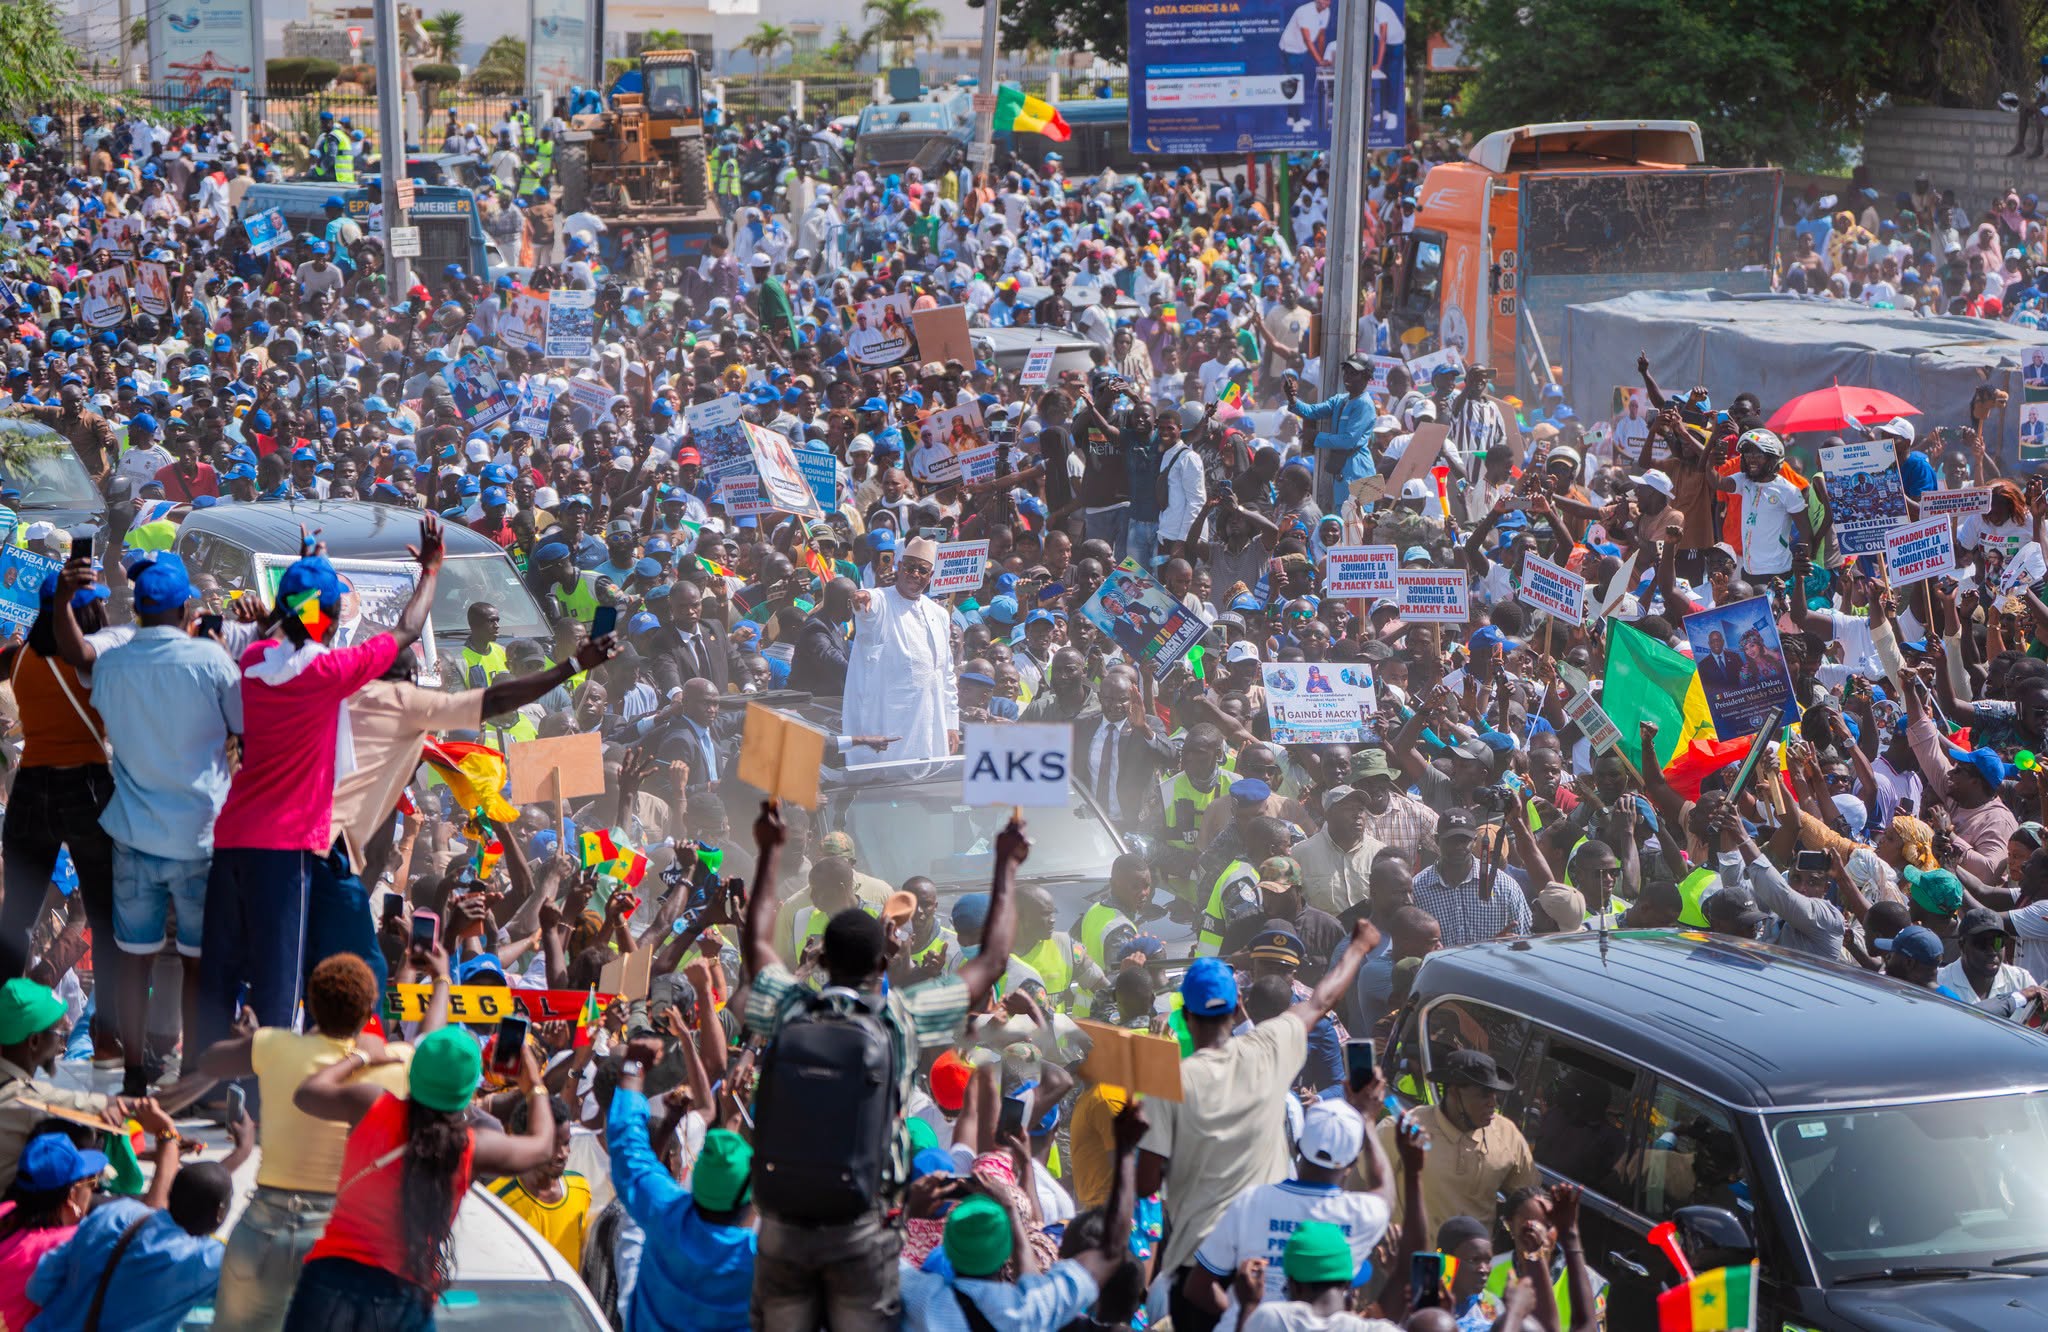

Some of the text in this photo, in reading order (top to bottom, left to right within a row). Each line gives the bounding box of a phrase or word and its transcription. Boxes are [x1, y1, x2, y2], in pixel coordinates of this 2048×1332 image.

[1153, 3, 1240, 15] DATA SCIENCE & IA
[1503, 251, 1514, 269] 90
[1503, 273, 1514, 290] 80
[1501, 297, 1515, 314] 60
[961, 452, 991, 465] MAMADOU
[1923, 493, 1962, 502] MAMADOU
[1932, 497, 1968, 506] SOUTIENT
[1923, 502, 1977, 512] CANDIDATURE
[1844, 517, 1898, 530] BIENVENUE
[1889, 532, 1924, 549] MAMADOU
[1924, 523, 1947, 537] GUEYE
[1987, 534, 2006, 543] FREE
[1897, 535, 1941, 556] SOUTIENT LA
[6, 546, 44, 567] FARBA
[938, 547, 986, 560] MAMADOU GUEYE
[1331, 553, 1395, 563] MAMADOU GUEYE
[1892, 543, 1950, 569] CANDIDATURE DE
[944, 557, 978, 568] SOUHAITE LA
[1340, 562, 1387, 572] SOUHAITE LA
[1898, 555, 1945, 577] MACKY SALL
[941, 565, 978, 577] BIENVENUE AU
[1338, 571, 1389, 581] BIENVENUE AU
[1526, 560, 1581, 593] MAMADOU GUEYE
[934, 574, 980, 587] PR.MACKY SALL
[1331, 580, 1395, 591] PR.MACKY SALL
[1397, 577, 1463, 586] MAMADOU GUEYE
[1533, 572, 1573, 598] SOUHAITE LA
[1408, 586, 1455, 595] SOUHAITE LA
[1530, 580, 1574, 607] BIENVENUE AU
[1406, 595, 1458, 604] BIENVENUE AU
[1523, 586, 1578, 619] PR.MACKY SALL
[0, 603, 31, 619] MACKY
[1400, 604, 1464, 614] PR.MACKY SALL
[1155, 631, 1181, 663] MACKY
[1178, 617, 1199, 643] SALL
[1723, 686, 1756, 699] Bienvenue
[1761, 679, 1783, 689] Dakar,
[1714, 697, 1746, 710] Président
[1746, 692, 1768, 701] Macky
[1287, 708, 1358, 719] GAINDÉ MACKY
[969, 751, 1065, 781] AKS
